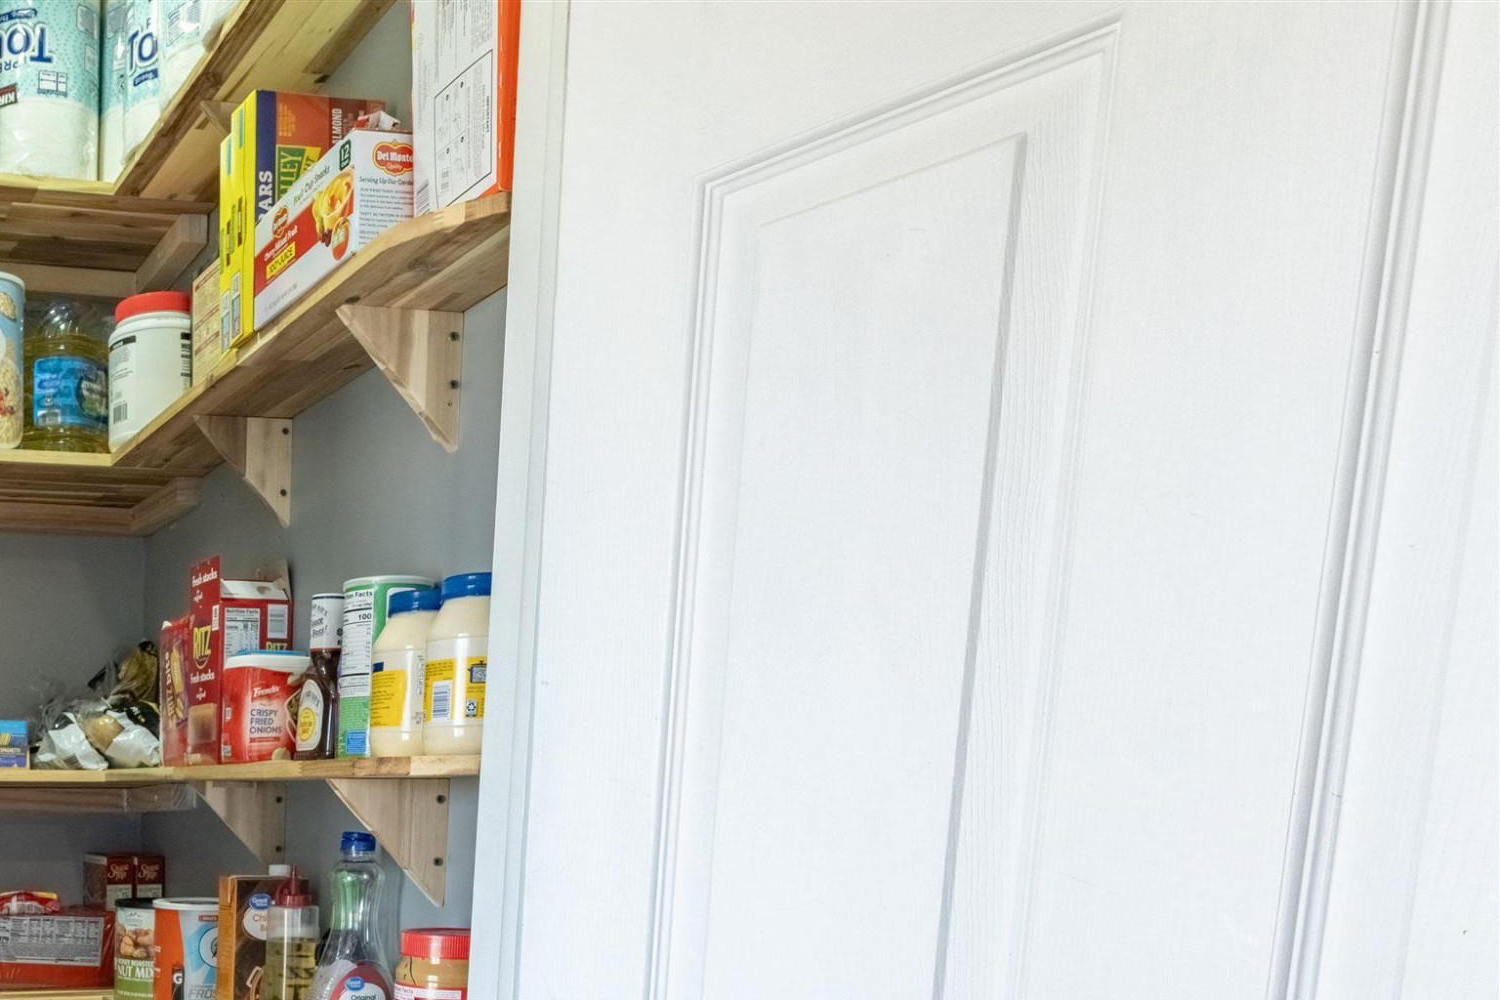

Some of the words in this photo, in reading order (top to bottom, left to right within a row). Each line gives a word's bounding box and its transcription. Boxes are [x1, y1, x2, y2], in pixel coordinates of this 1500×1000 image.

[376, 150, 389, 161] Del
[359, 176, 379, 187] Serving
[354, 590, 373, 598] Facts
[358, 612, 373, 621] 100
[192, 624, 212, 659] RITZ
[250, 708, 278, 718] CRISPY
[250, 717, 274, 726] FRIED
[250, 726, 283, 736] ONIONS
[117, 965, 133, 977] NUT
[135, 966, 156, 979] MIX
[173, 973, 183, 984] G
